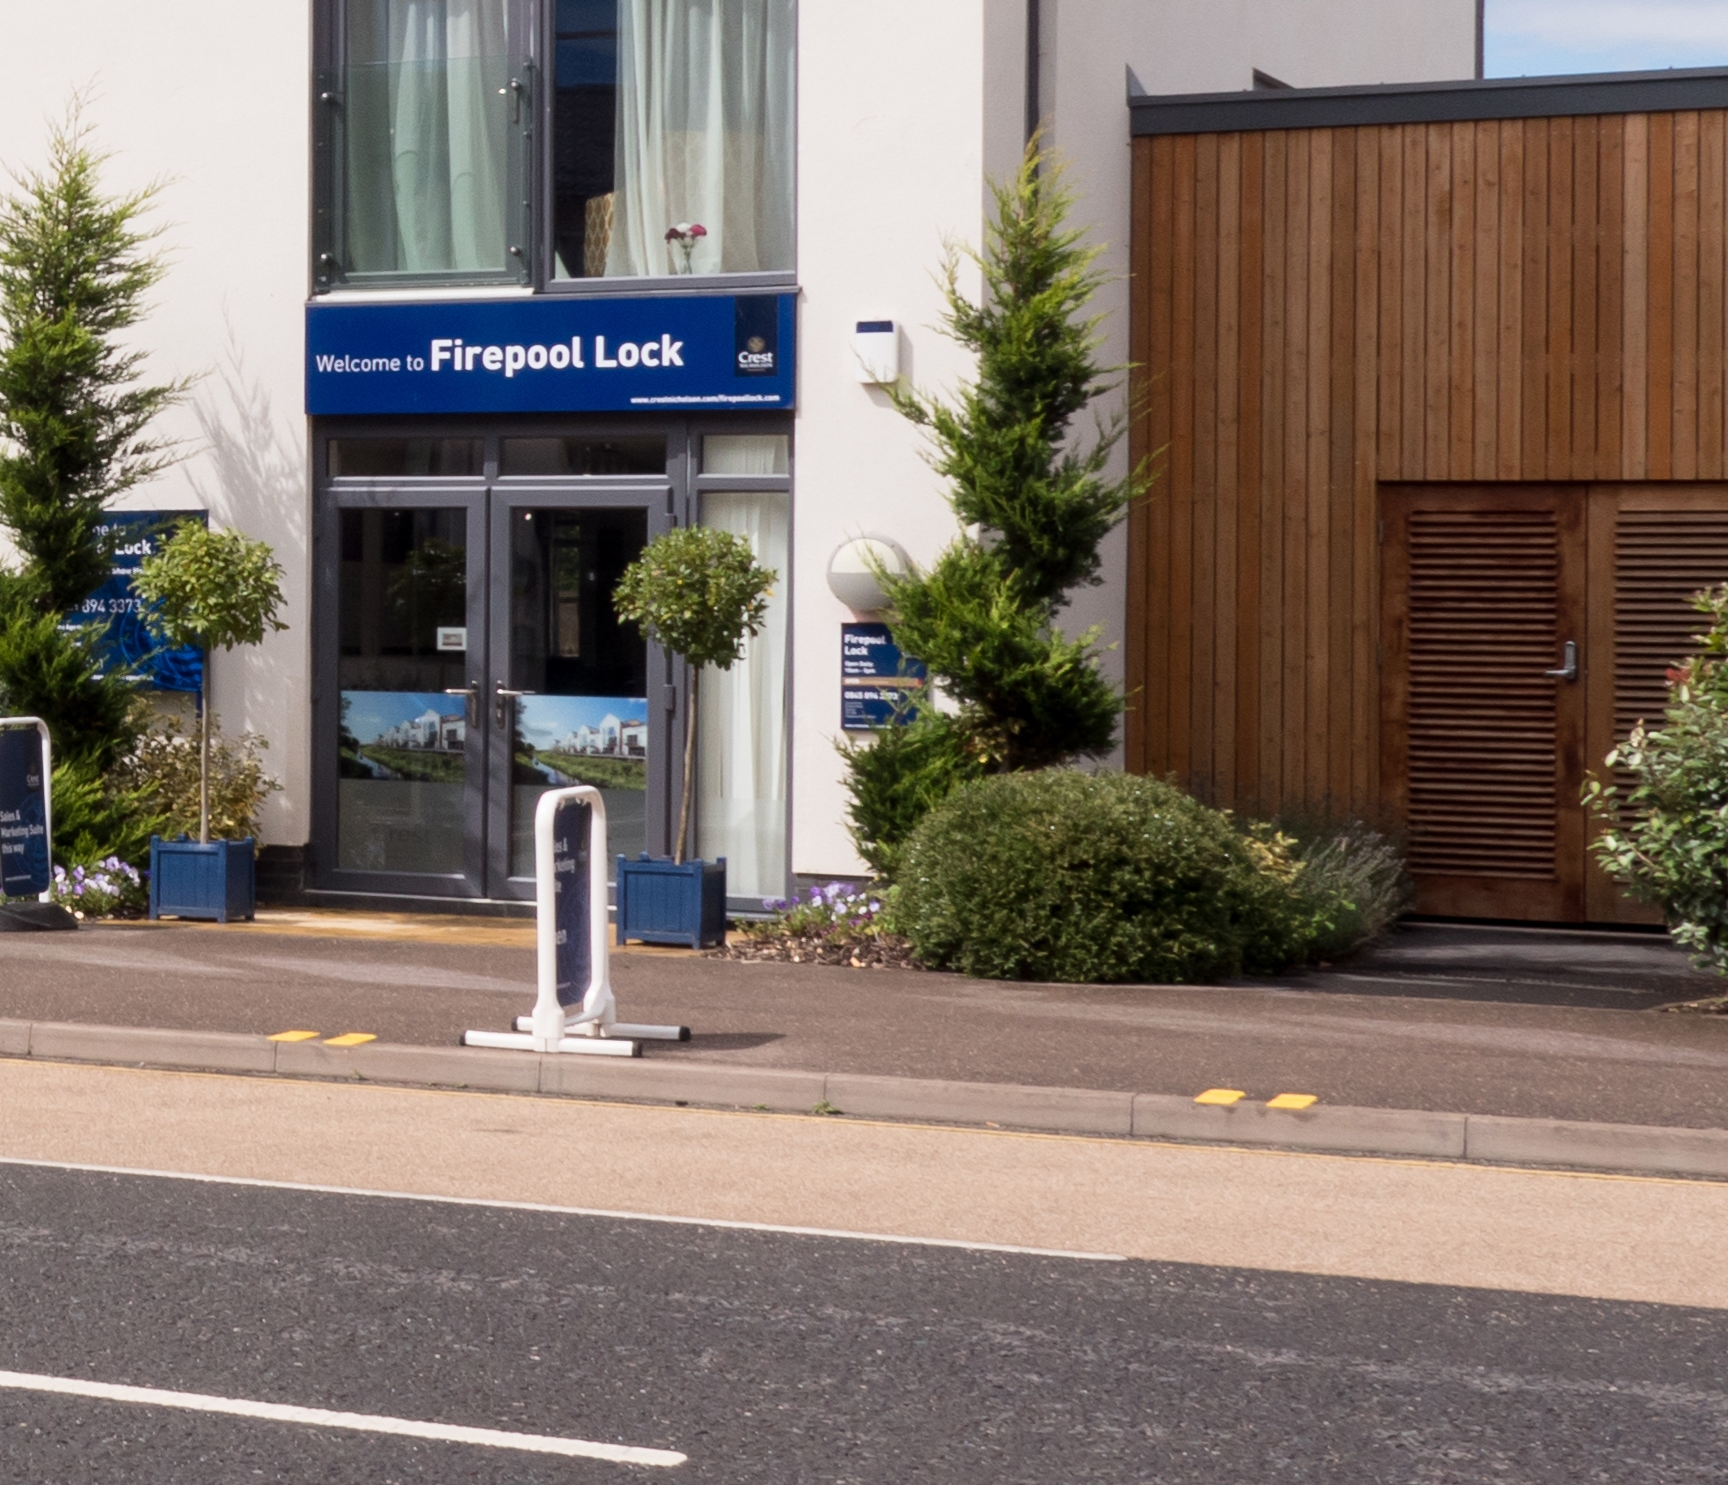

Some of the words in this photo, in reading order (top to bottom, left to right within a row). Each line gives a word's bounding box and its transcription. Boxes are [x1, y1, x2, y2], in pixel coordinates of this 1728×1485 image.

[317, 354, 401, 373] Welcome
[406, 355, 424, 372] to
[431, 335, 584, 377] Firepool
[595, 334, 684, 369] Lock
[738, 351, 773, 363] Crest
[844, 633, 886, 646] Firepool
[844, 645, 869, 656] Lock
